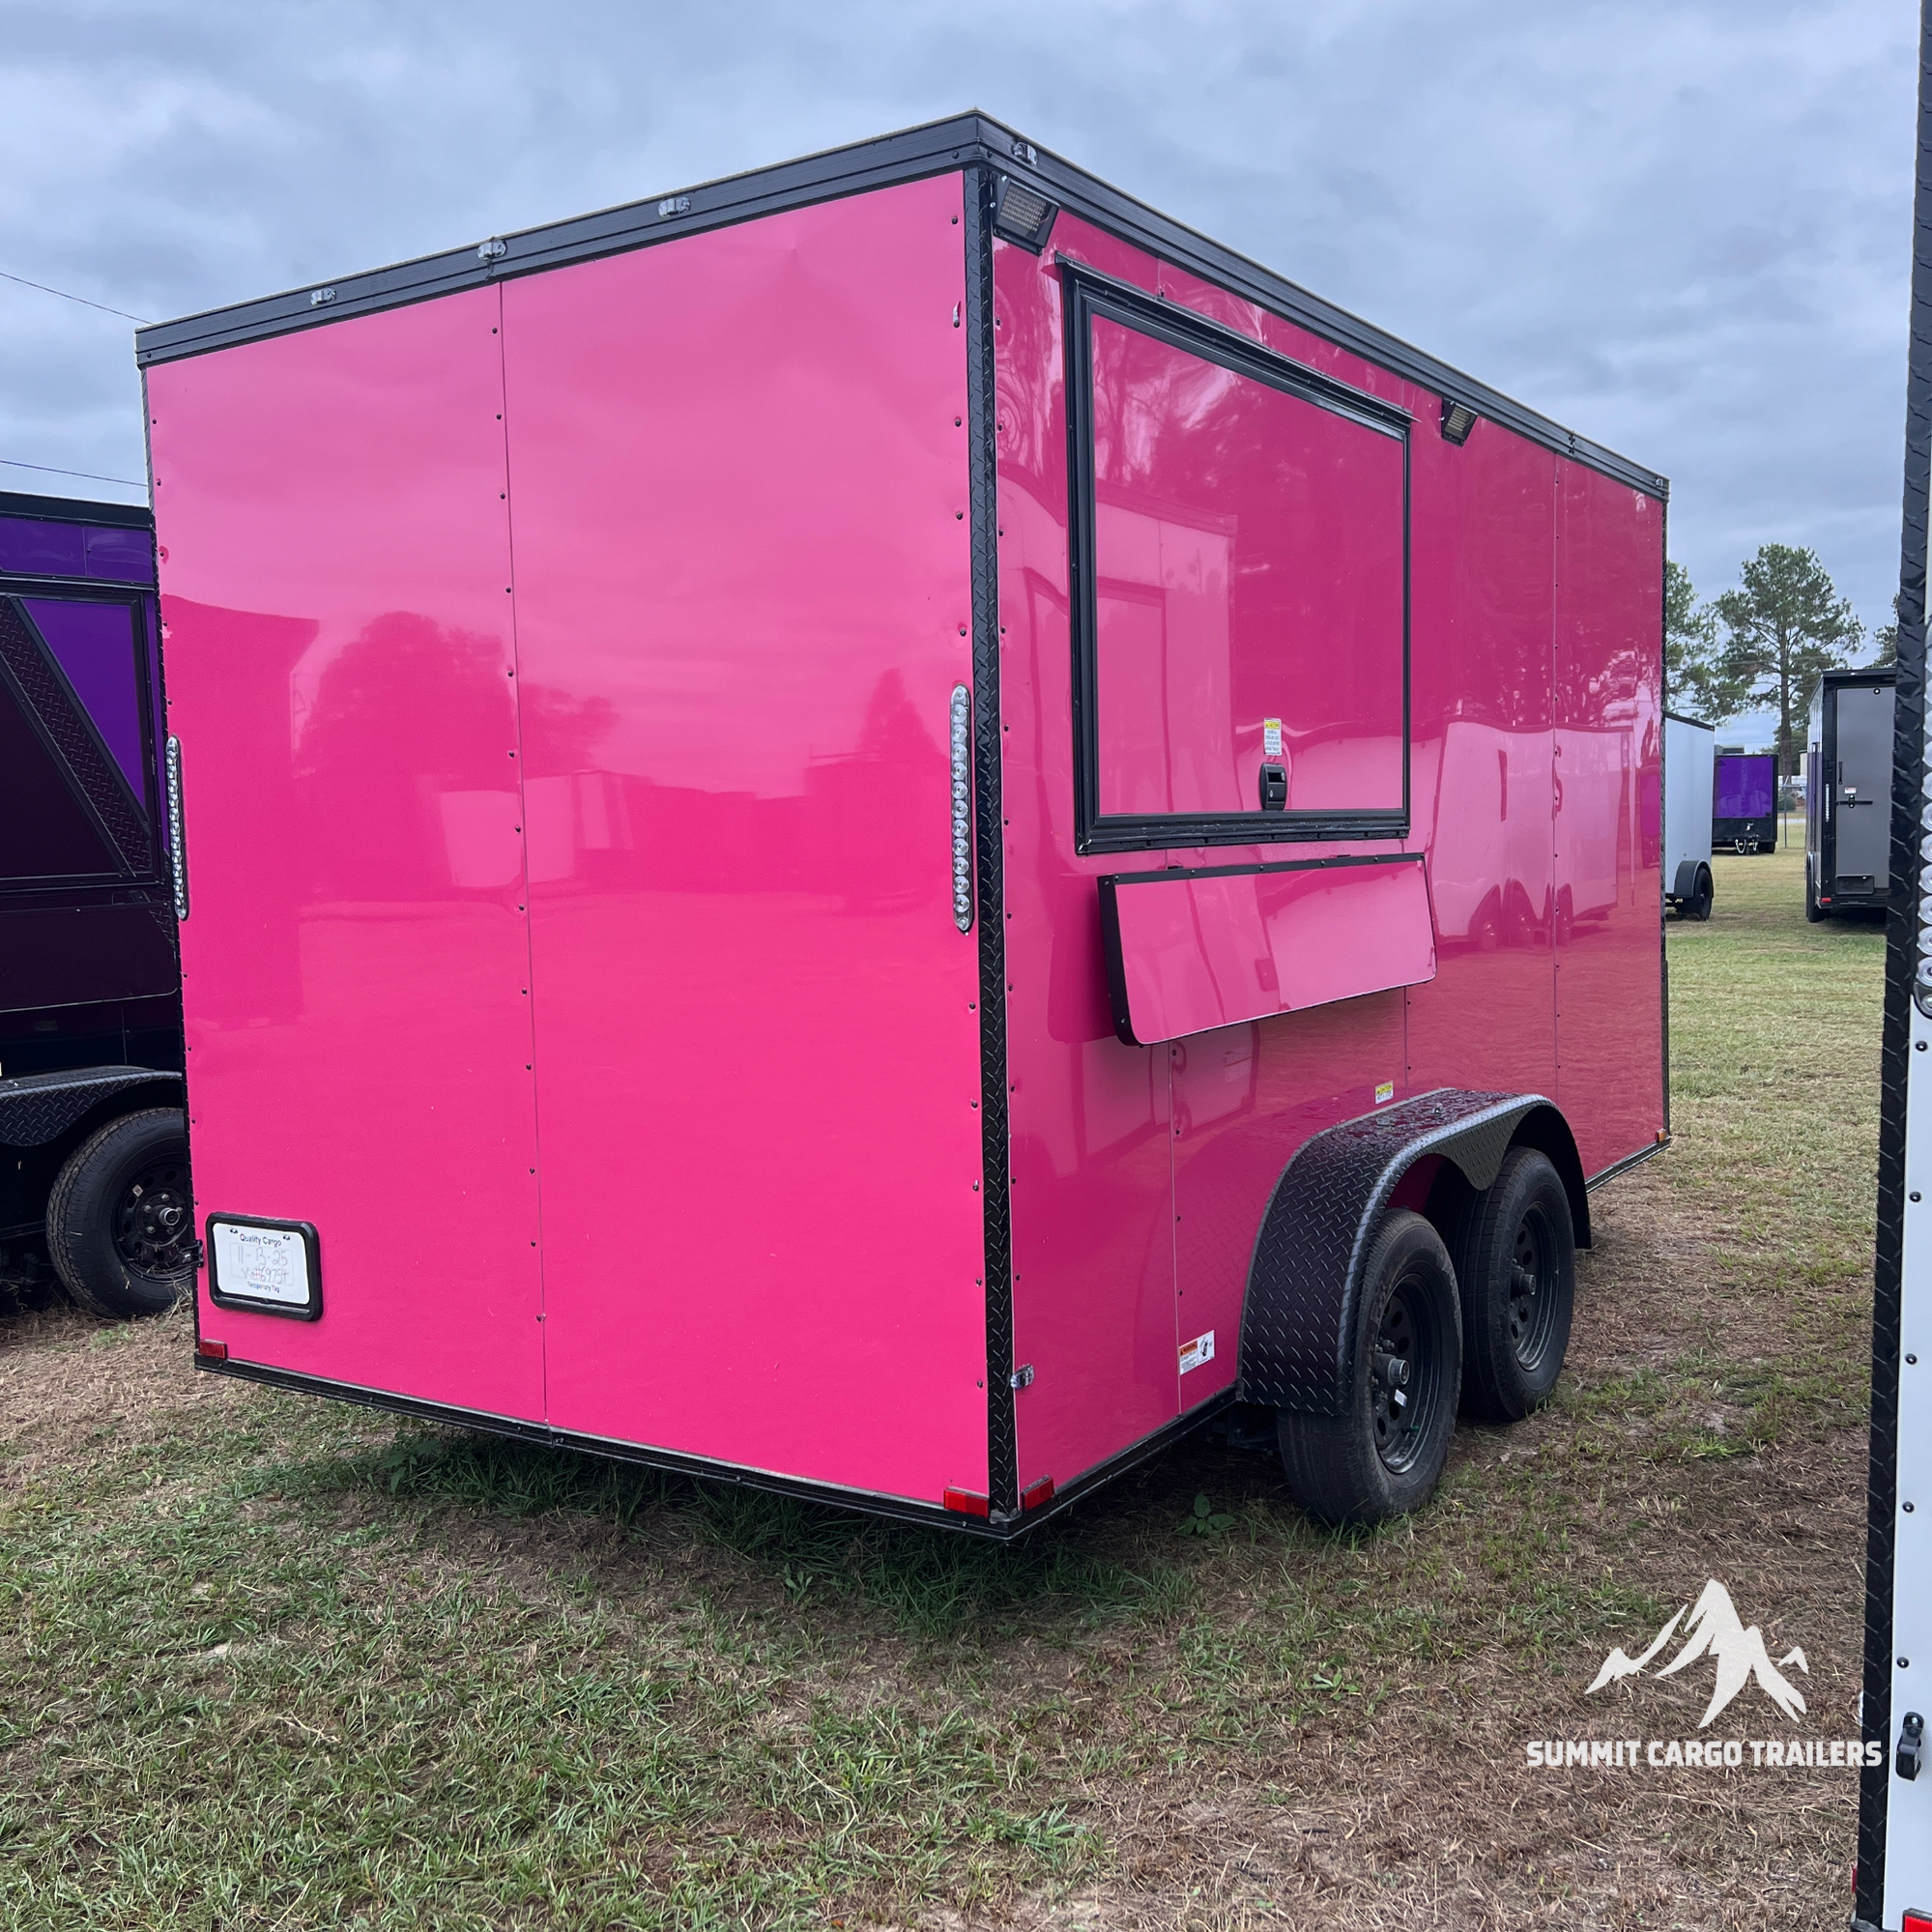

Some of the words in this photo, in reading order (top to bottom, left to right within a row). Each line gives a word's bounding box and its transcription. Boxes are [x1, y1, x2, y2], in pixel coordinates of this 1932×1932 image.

[240, 1233, 261, 1245] Quality
[263, 1236, 282, 1248] Cargo
[247, 1281, 271, 1292] Temporary
[272, 1284, 280, 1293] Tag
